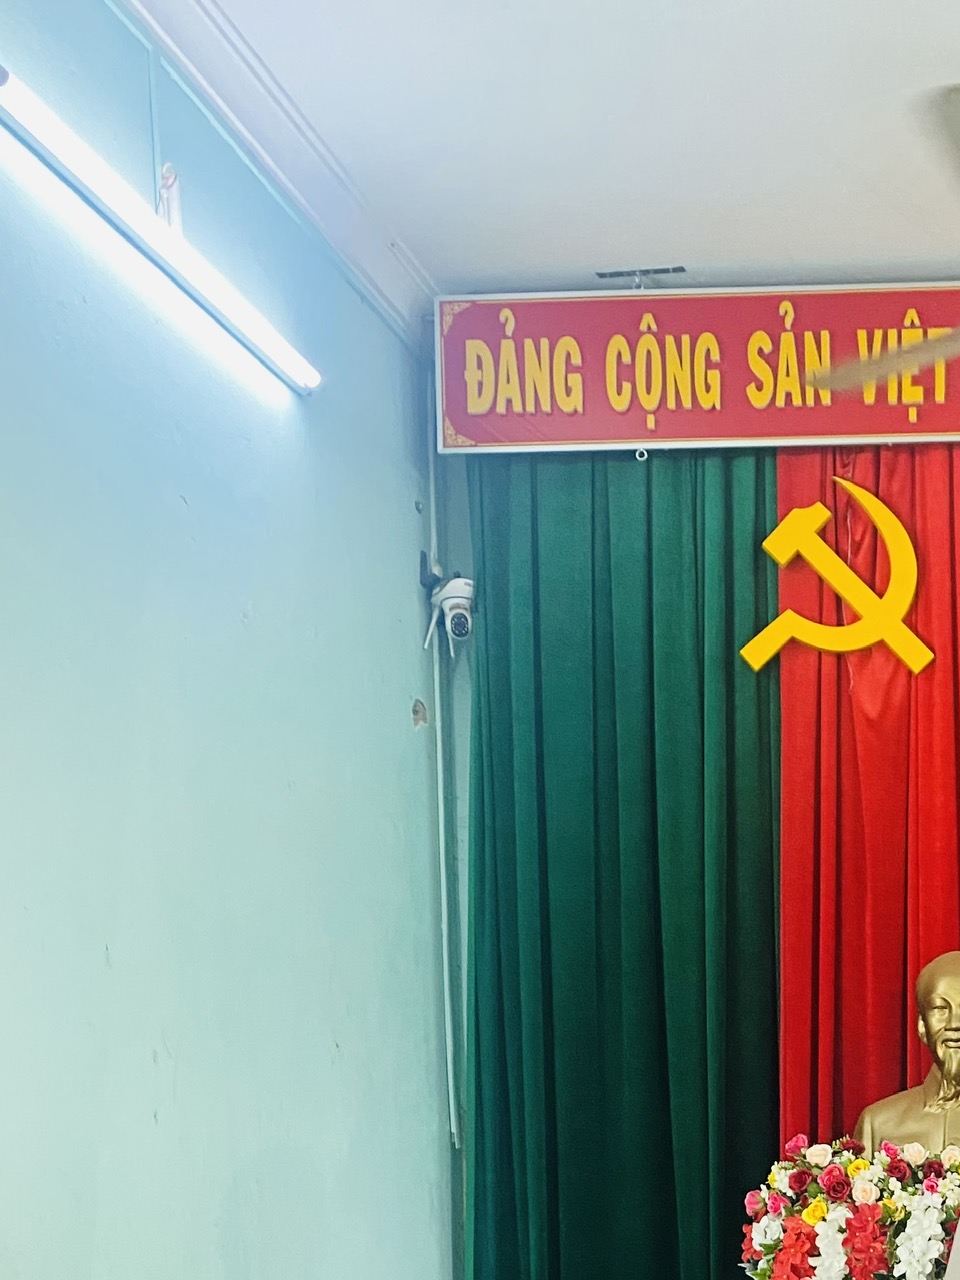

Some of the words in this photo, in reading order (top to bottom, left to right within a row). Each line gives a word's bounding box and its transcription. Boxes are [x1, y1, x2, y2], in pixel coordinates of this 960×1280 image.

[465, 308, 584, 415] ĐẢNG
[606, 312, 722, 430] CỘNG
[746, 300, 832, 409] SẢN
[857, 308, 952, 423] VIỆT
